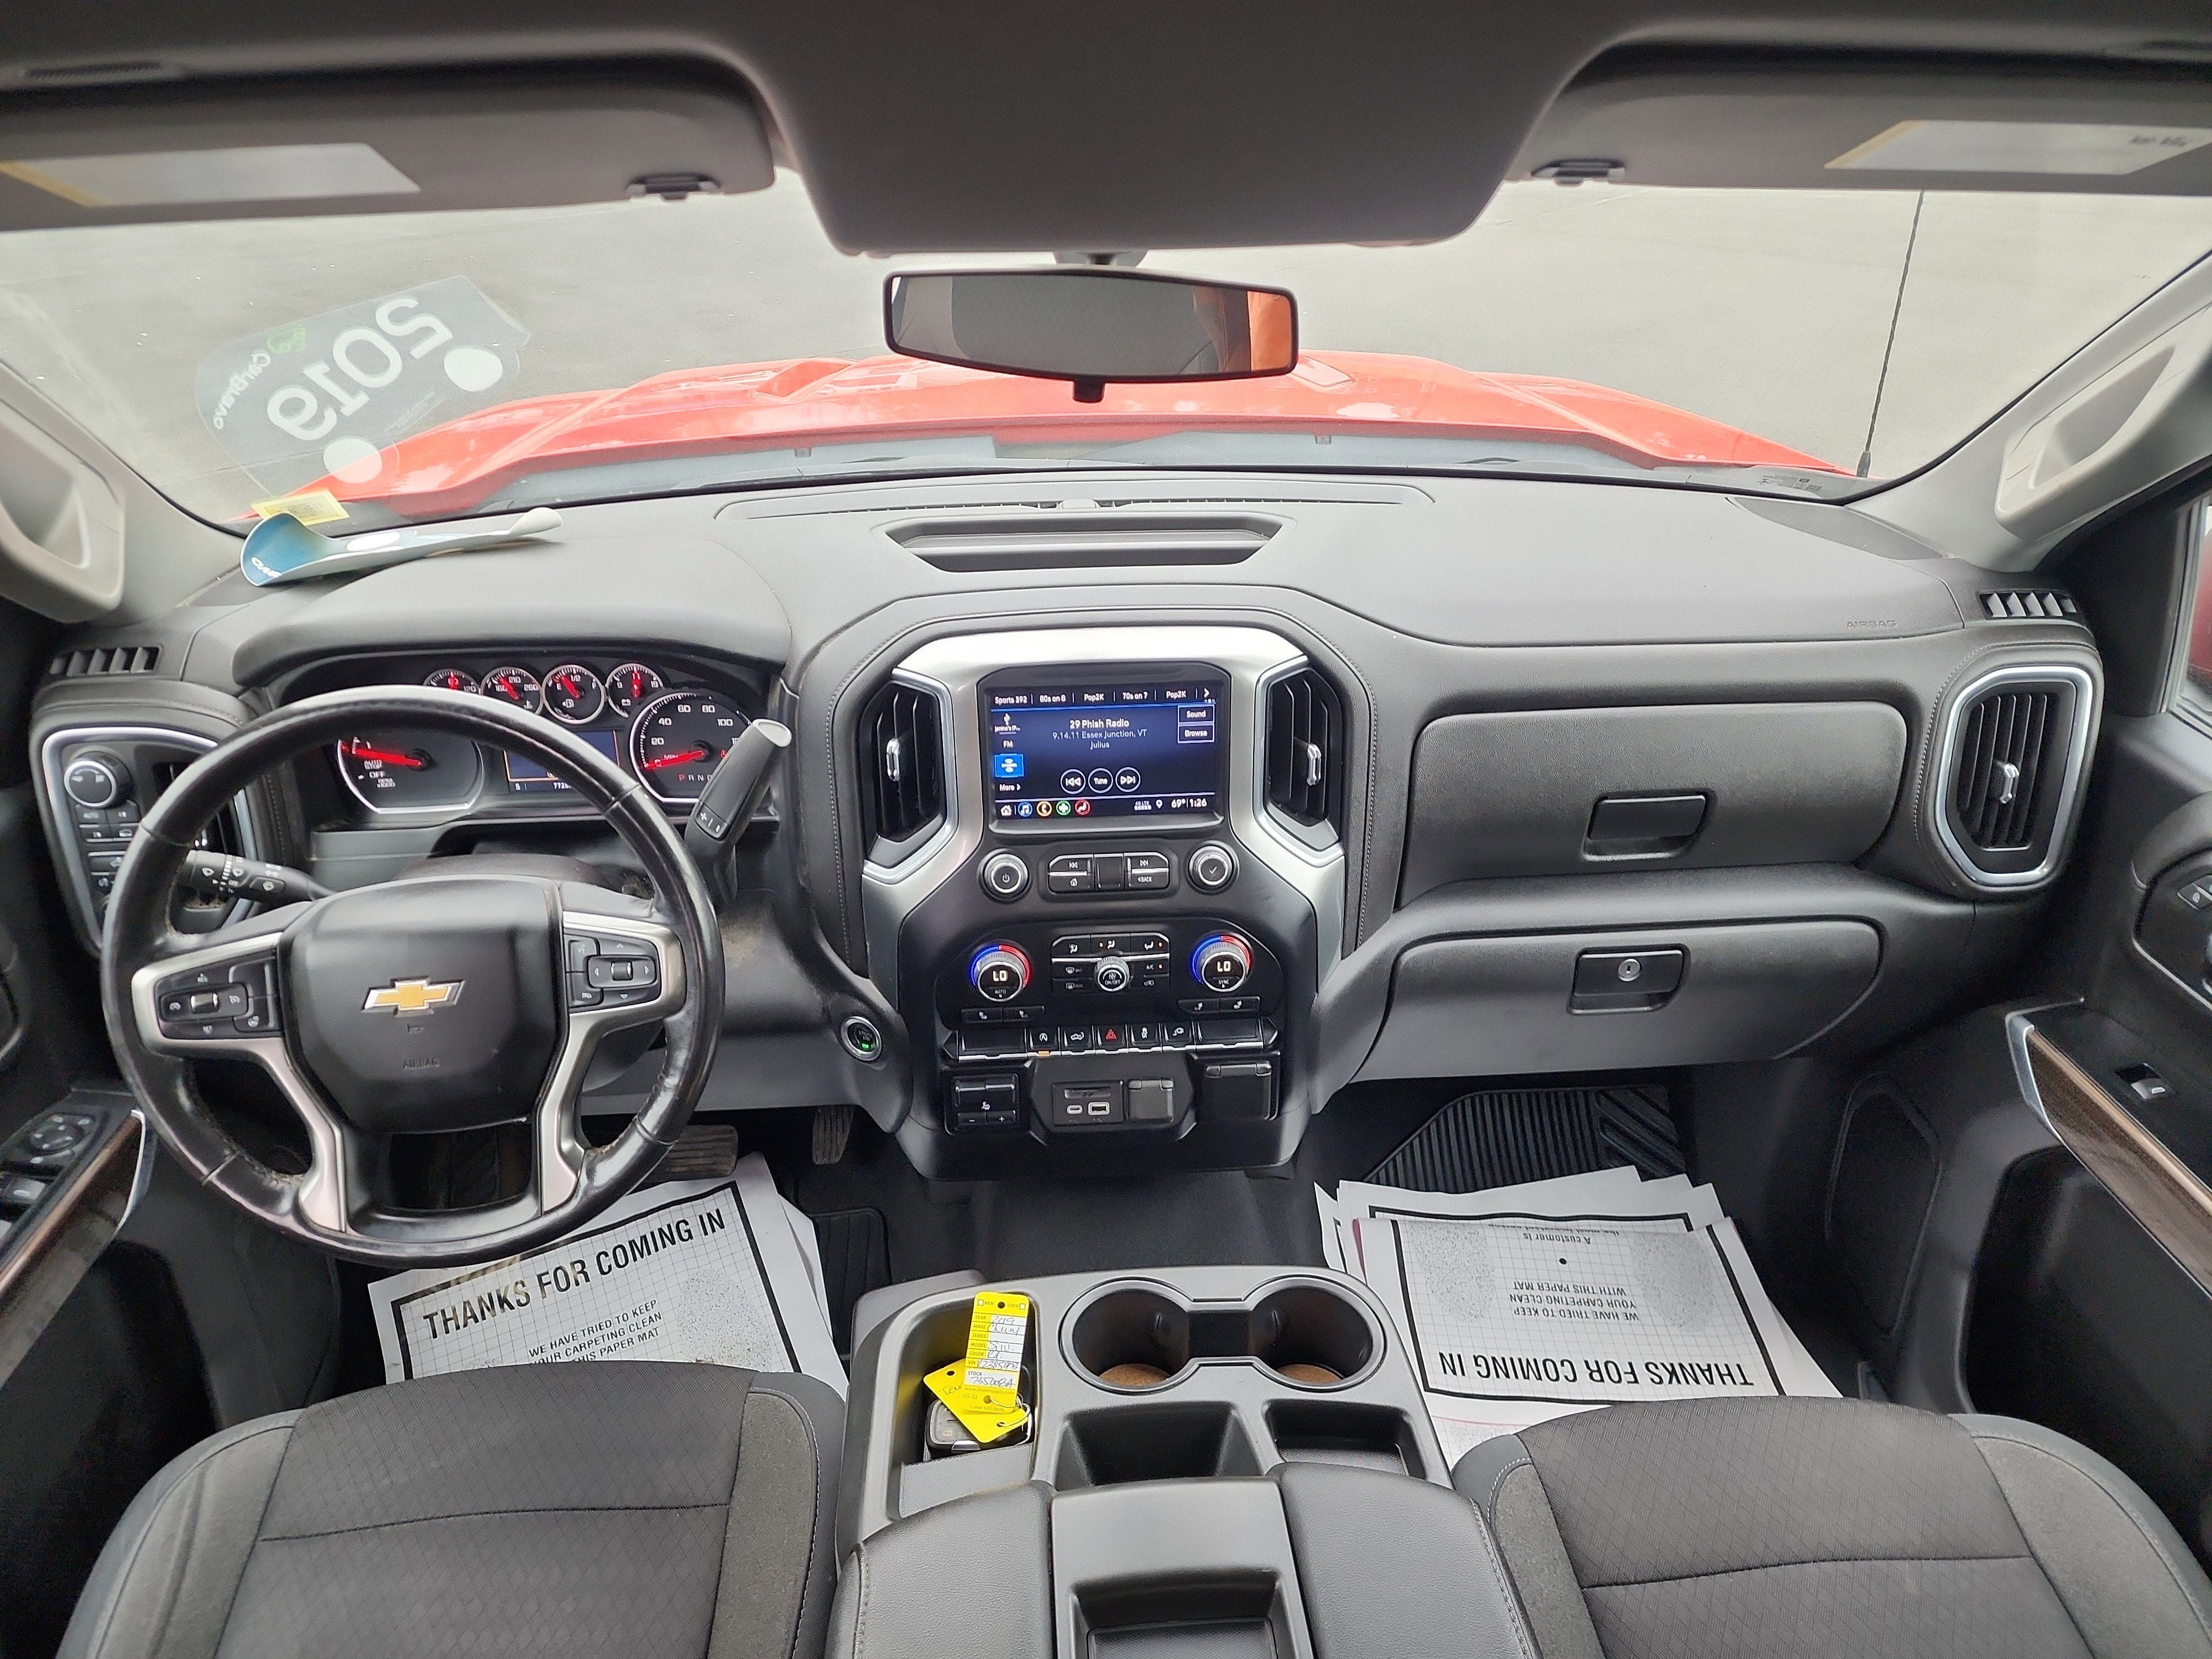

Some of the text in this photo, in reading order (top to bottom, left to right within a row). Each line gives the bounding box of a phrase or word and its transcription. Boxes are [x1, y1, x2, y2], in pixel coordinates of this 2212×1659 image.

[1084, 693, 1104, 702] Pop2K
[1166, 690, 1187, 699] Pop2K
[995, 695, 1027, 706] Sports 392
[1186, 709, 1207, 718] Sound
[658, 717, 672, 726] 40
[717, 718, 733, 727] 100
[1070, 718, 1130, 729] 29 Phish Radio
[1052, 731, 1079, 740] 9.14.11
[1104, 729, 1136, 739] Junction,
[1137, 728, 1147, 737] VT
[1003, 740, 1013, 748] FM
[1090, 740, 1110, 750] Julius
[1094, 777, 1108, 785] Tune
[1190, 798, 1207, 807] 1:26
[1524, 1233, 1532, 1241] is
[1536, 1233, 1582, 1244] customer
[423, 1208, 726, 1340] THANKS FOR COMING IN
[1513, 1281, 1626, 1296] WITH THIS PAPER MAT
[1509, 1293, 1637, 1309] YOUR CARPETING CLEAN
[1514, 1306, 1640, 1321] WE HAVE TRIED TO KEEP
[529, 1299, 657, 1358] WE HAVE TRIED TO KEEP
[534, 1311, 662, 1364] OUR CARPETING CLEAN
[573, 1326, 660, 1362] HIS PAPER MAT
[1439, 1352, 1754, 1386] THANKS FOR COMING IN
